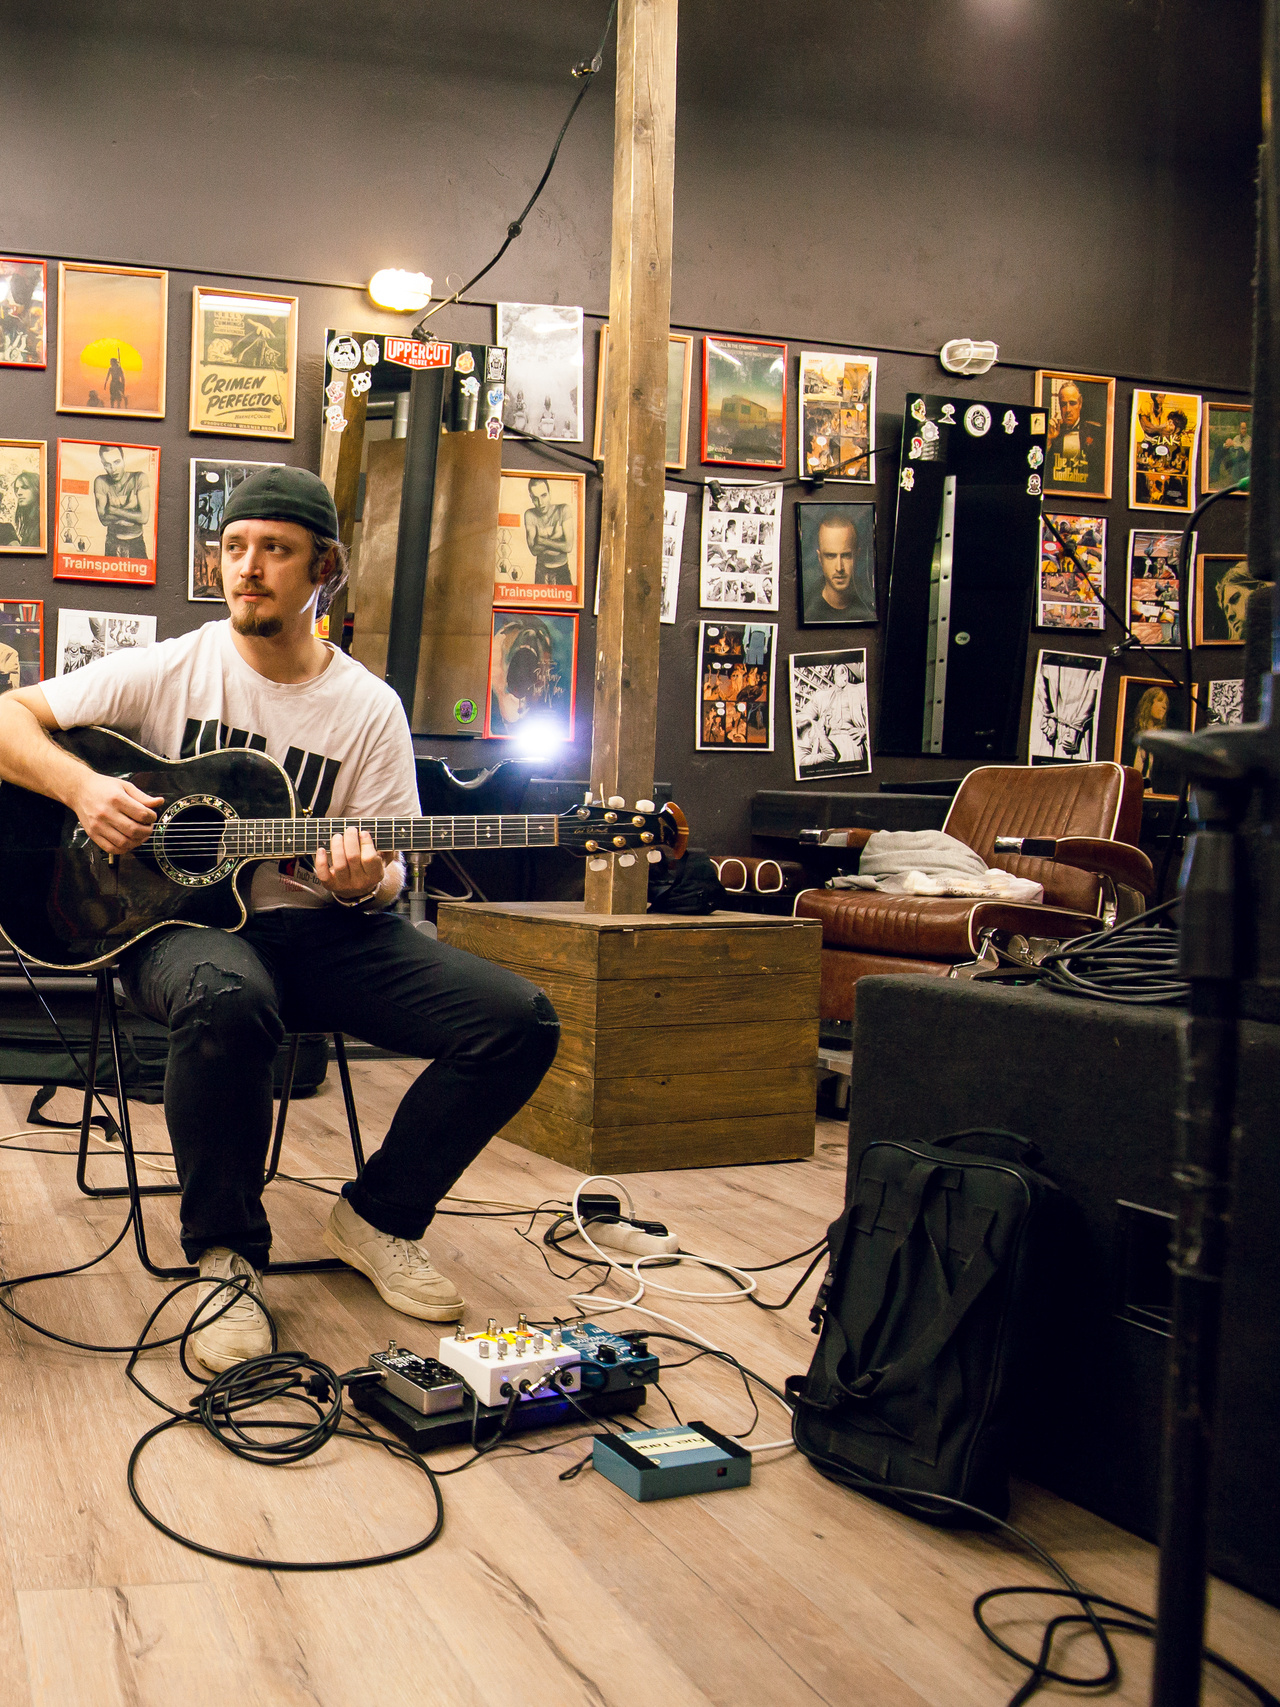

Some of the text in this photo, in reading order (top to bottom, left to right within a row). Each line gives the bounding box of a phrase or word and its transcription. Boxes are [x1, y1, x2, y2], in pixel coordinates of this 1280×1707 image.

[387, 339, 450, 364] UPPERCUT
[408, 358, 428, 366] DELUXE
[201, 373, 267, 396] CRIMEN
[206, 393, 272, 414] PERFECTO
[707, 445, 733, 455] Breaking
[1053, 453, 1068, 467] The
[1053, 466, 1089, 483] Godfather
[62, 556, 148, 576] Trainspotting
[498, 585, 573, 602] Trainspotting
